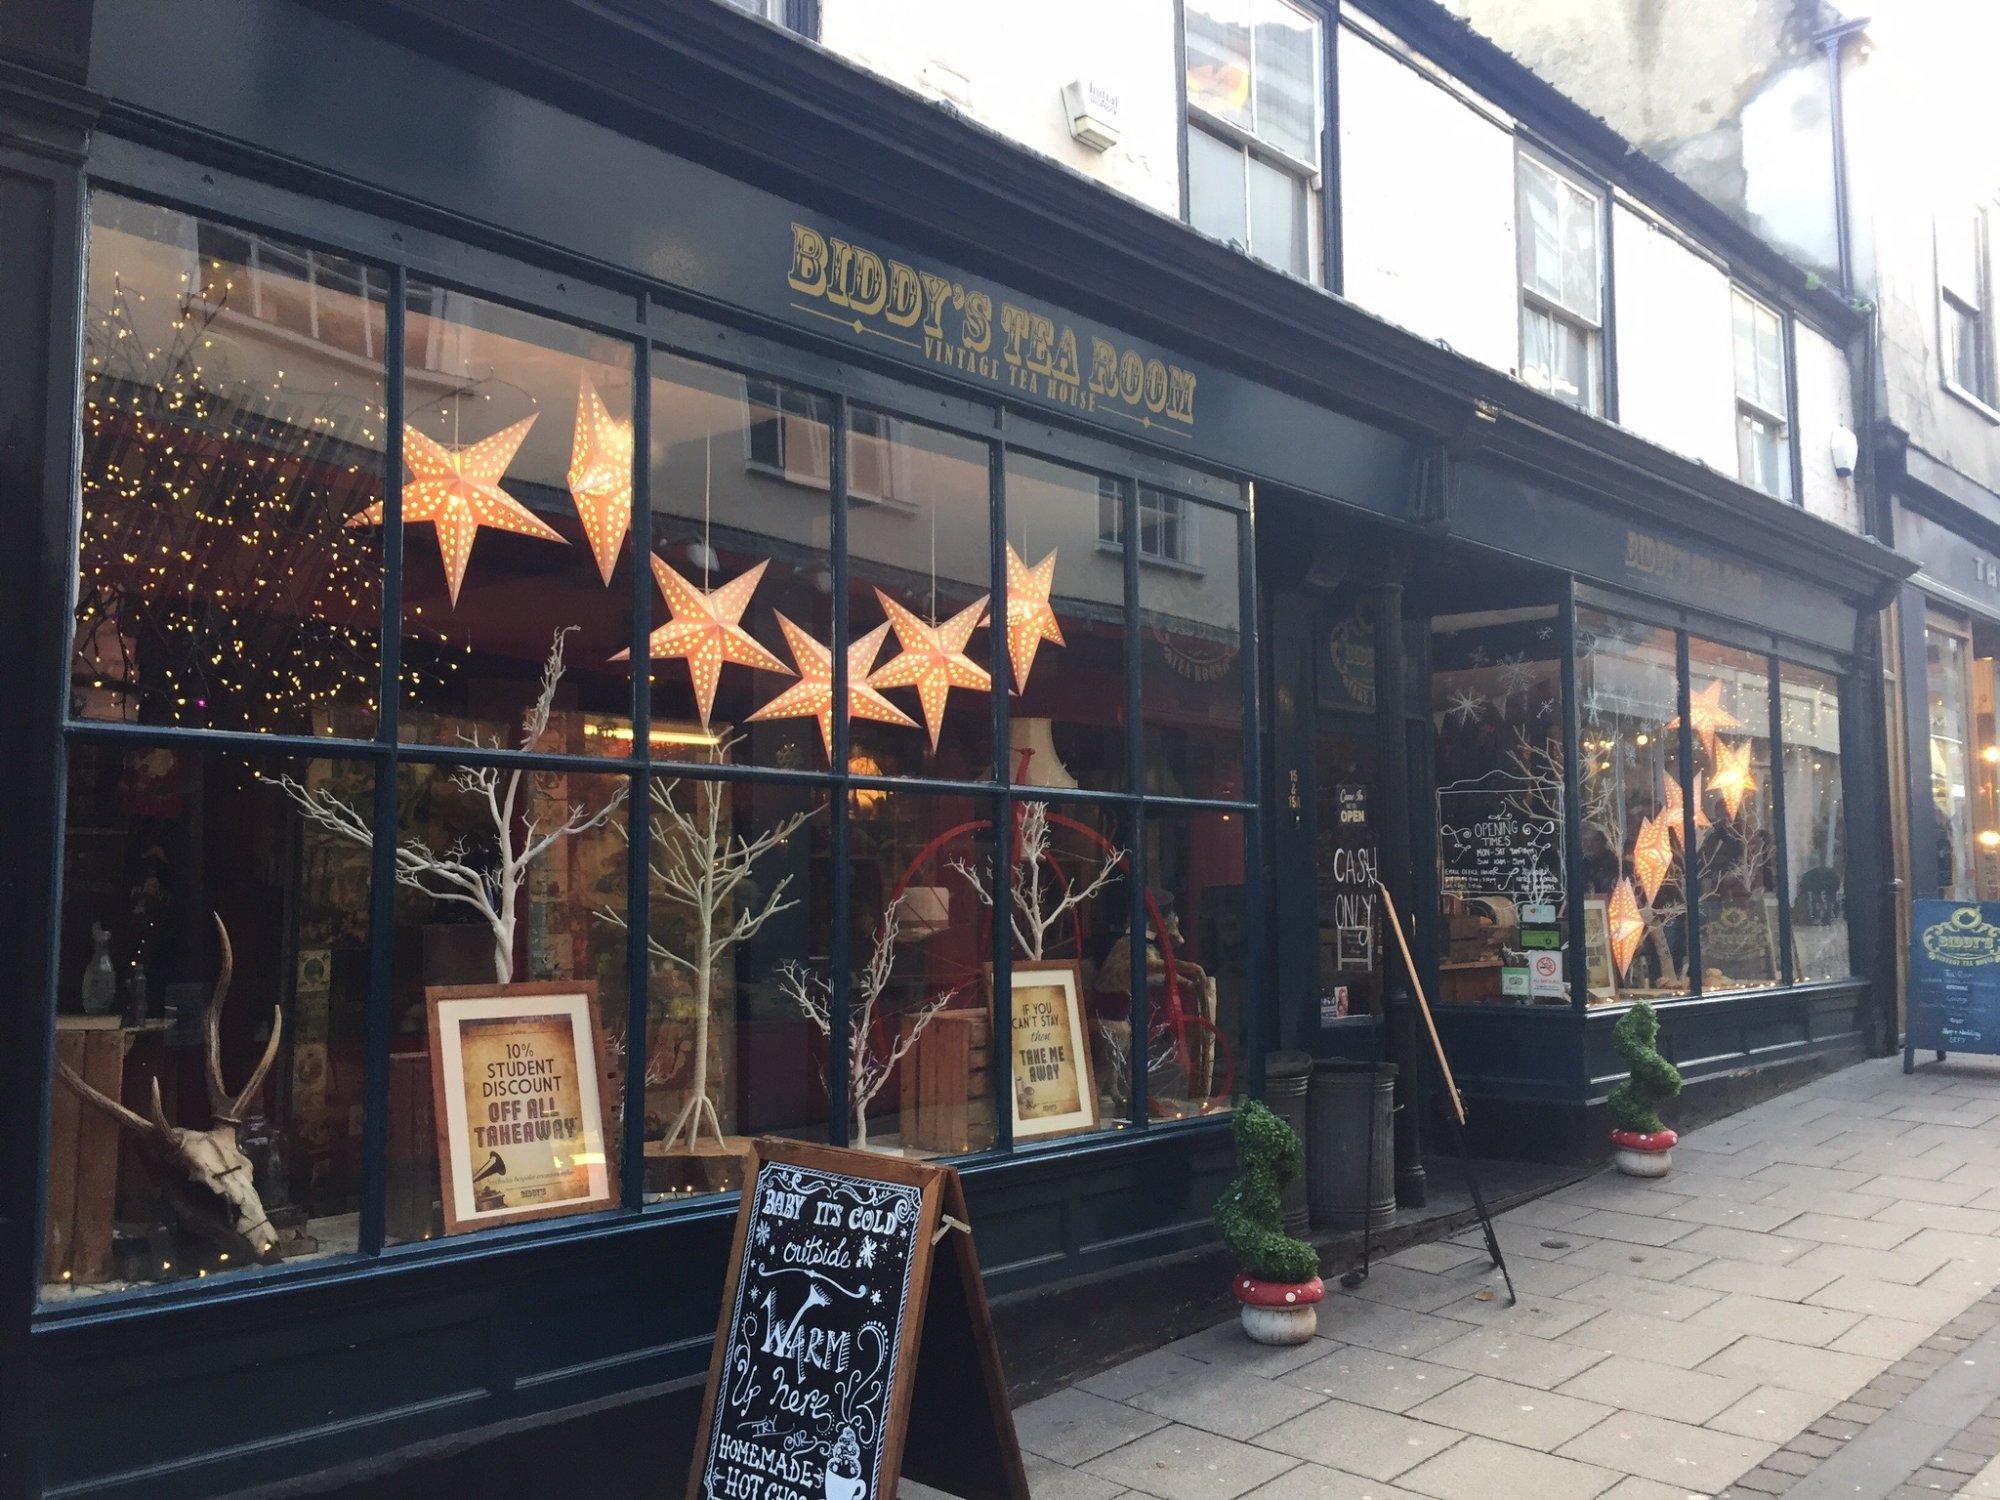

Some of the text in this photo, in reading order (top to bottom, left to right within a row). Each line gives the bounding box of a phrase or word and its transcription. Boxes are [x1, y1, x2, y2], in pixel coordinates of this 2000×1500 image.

[787, 222, 1197, 424] BIDDY'S TEA ROOM
[922, 337, 1096, 413] VINTAGE TEA HOUSE
[1341, 810, 1365, 823] OPEN
[1474, 820, 1518, 838] OPENING
[1481, 835, 1512, 847] TIMES
[1333, 846, 1379, 886] CASH
[1334, 894, 1377, 946] ONLY
[1022, 1001, 1052, 1016] IF YOU
[1012, 1015, 1038, 1030] CAN'T
[1031, 1030, 1051, 1041] then
[506, 1042, 534, 1059] 10%
[1019, 1045, 1065, 1066] TAKE ME
[486, 1058, 555, 1079] STUDENT
[1029, 1063, 1061, 1083] AWAY
[483, 1075, 563, 1098] DISCOUNT
[488, 1096, 560, 1123] OFF ALL
[762, 1188, 899, 1236] BABY IT'S COLD
[783, 1237, 853, 1269] outside
[760, 1283, 853, 1384] WARM
[769, 1367, 834, 1428] here
[751, 1415, 813, 1451] TRY OUR
[718, 1433, 815, 1489] HOMEMADE
[724, 1466, 765, 1500] HOT
